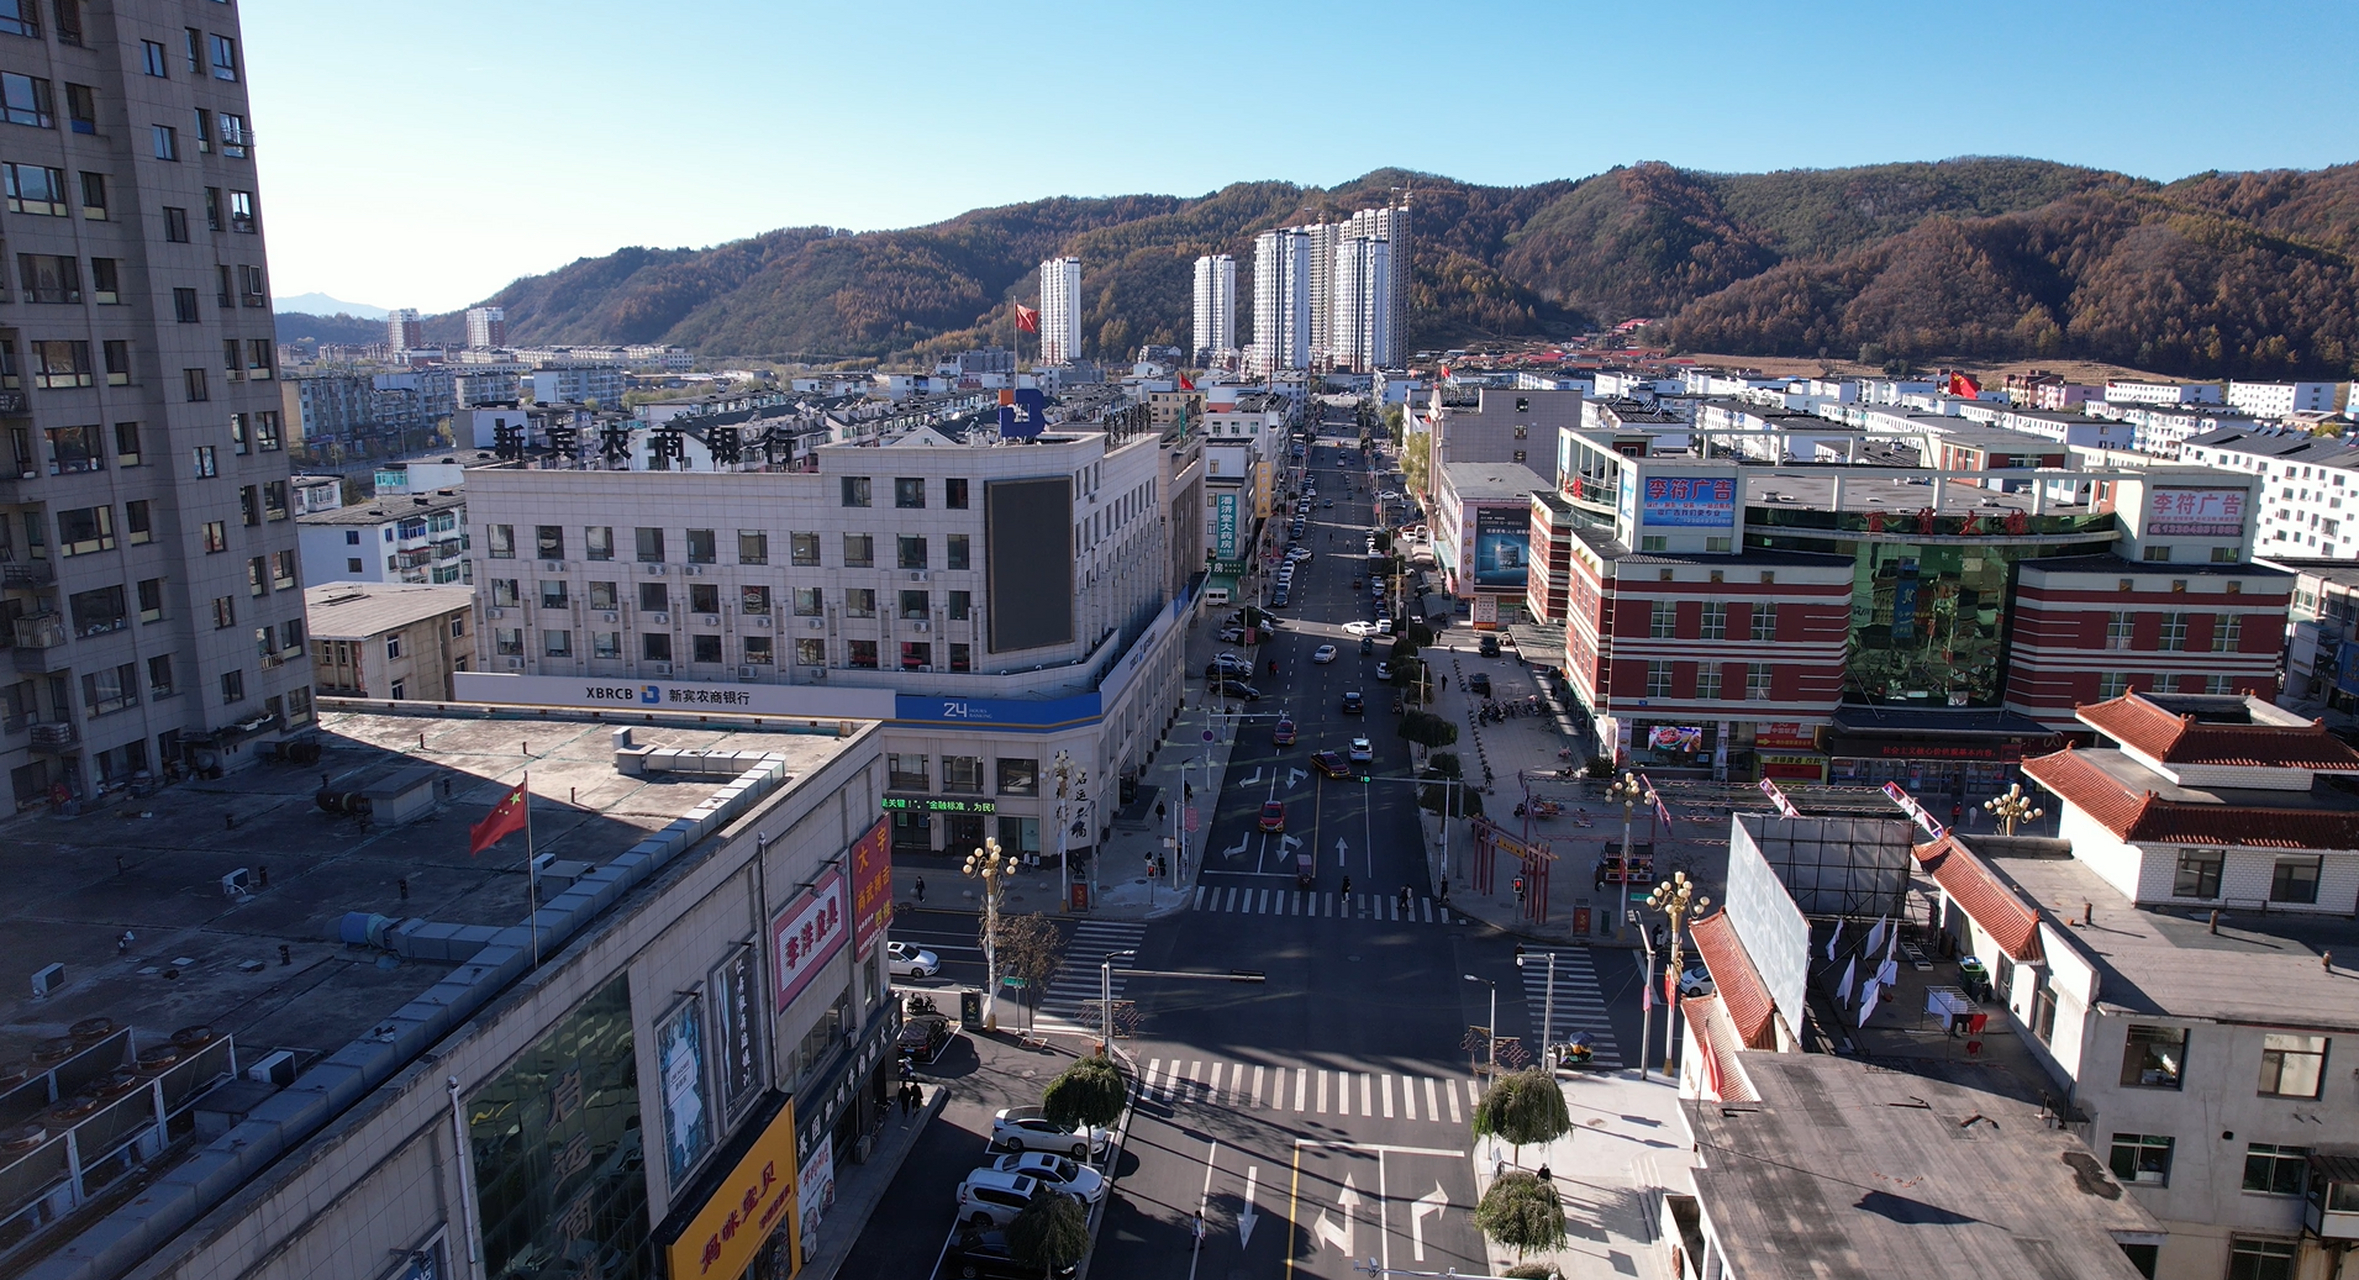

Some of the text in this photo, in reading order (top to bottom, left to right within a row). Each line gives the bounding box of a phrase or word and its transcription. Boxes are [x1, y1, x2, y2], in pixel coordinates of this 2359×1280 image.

[494, 424, 797, 464] 新宾农商银行
[1649, 479, 1733, 500] 李符广告
[2153, 492, 2241, 515] 李符广告
[1863, 507, 2029, 536] 百货大楼
[586, 687, 749, 705] XBRCB 新宾农商银行
[944, 702, 967, 718] 24
[700, 1160, 777, 1275] 妈咪宝贝
